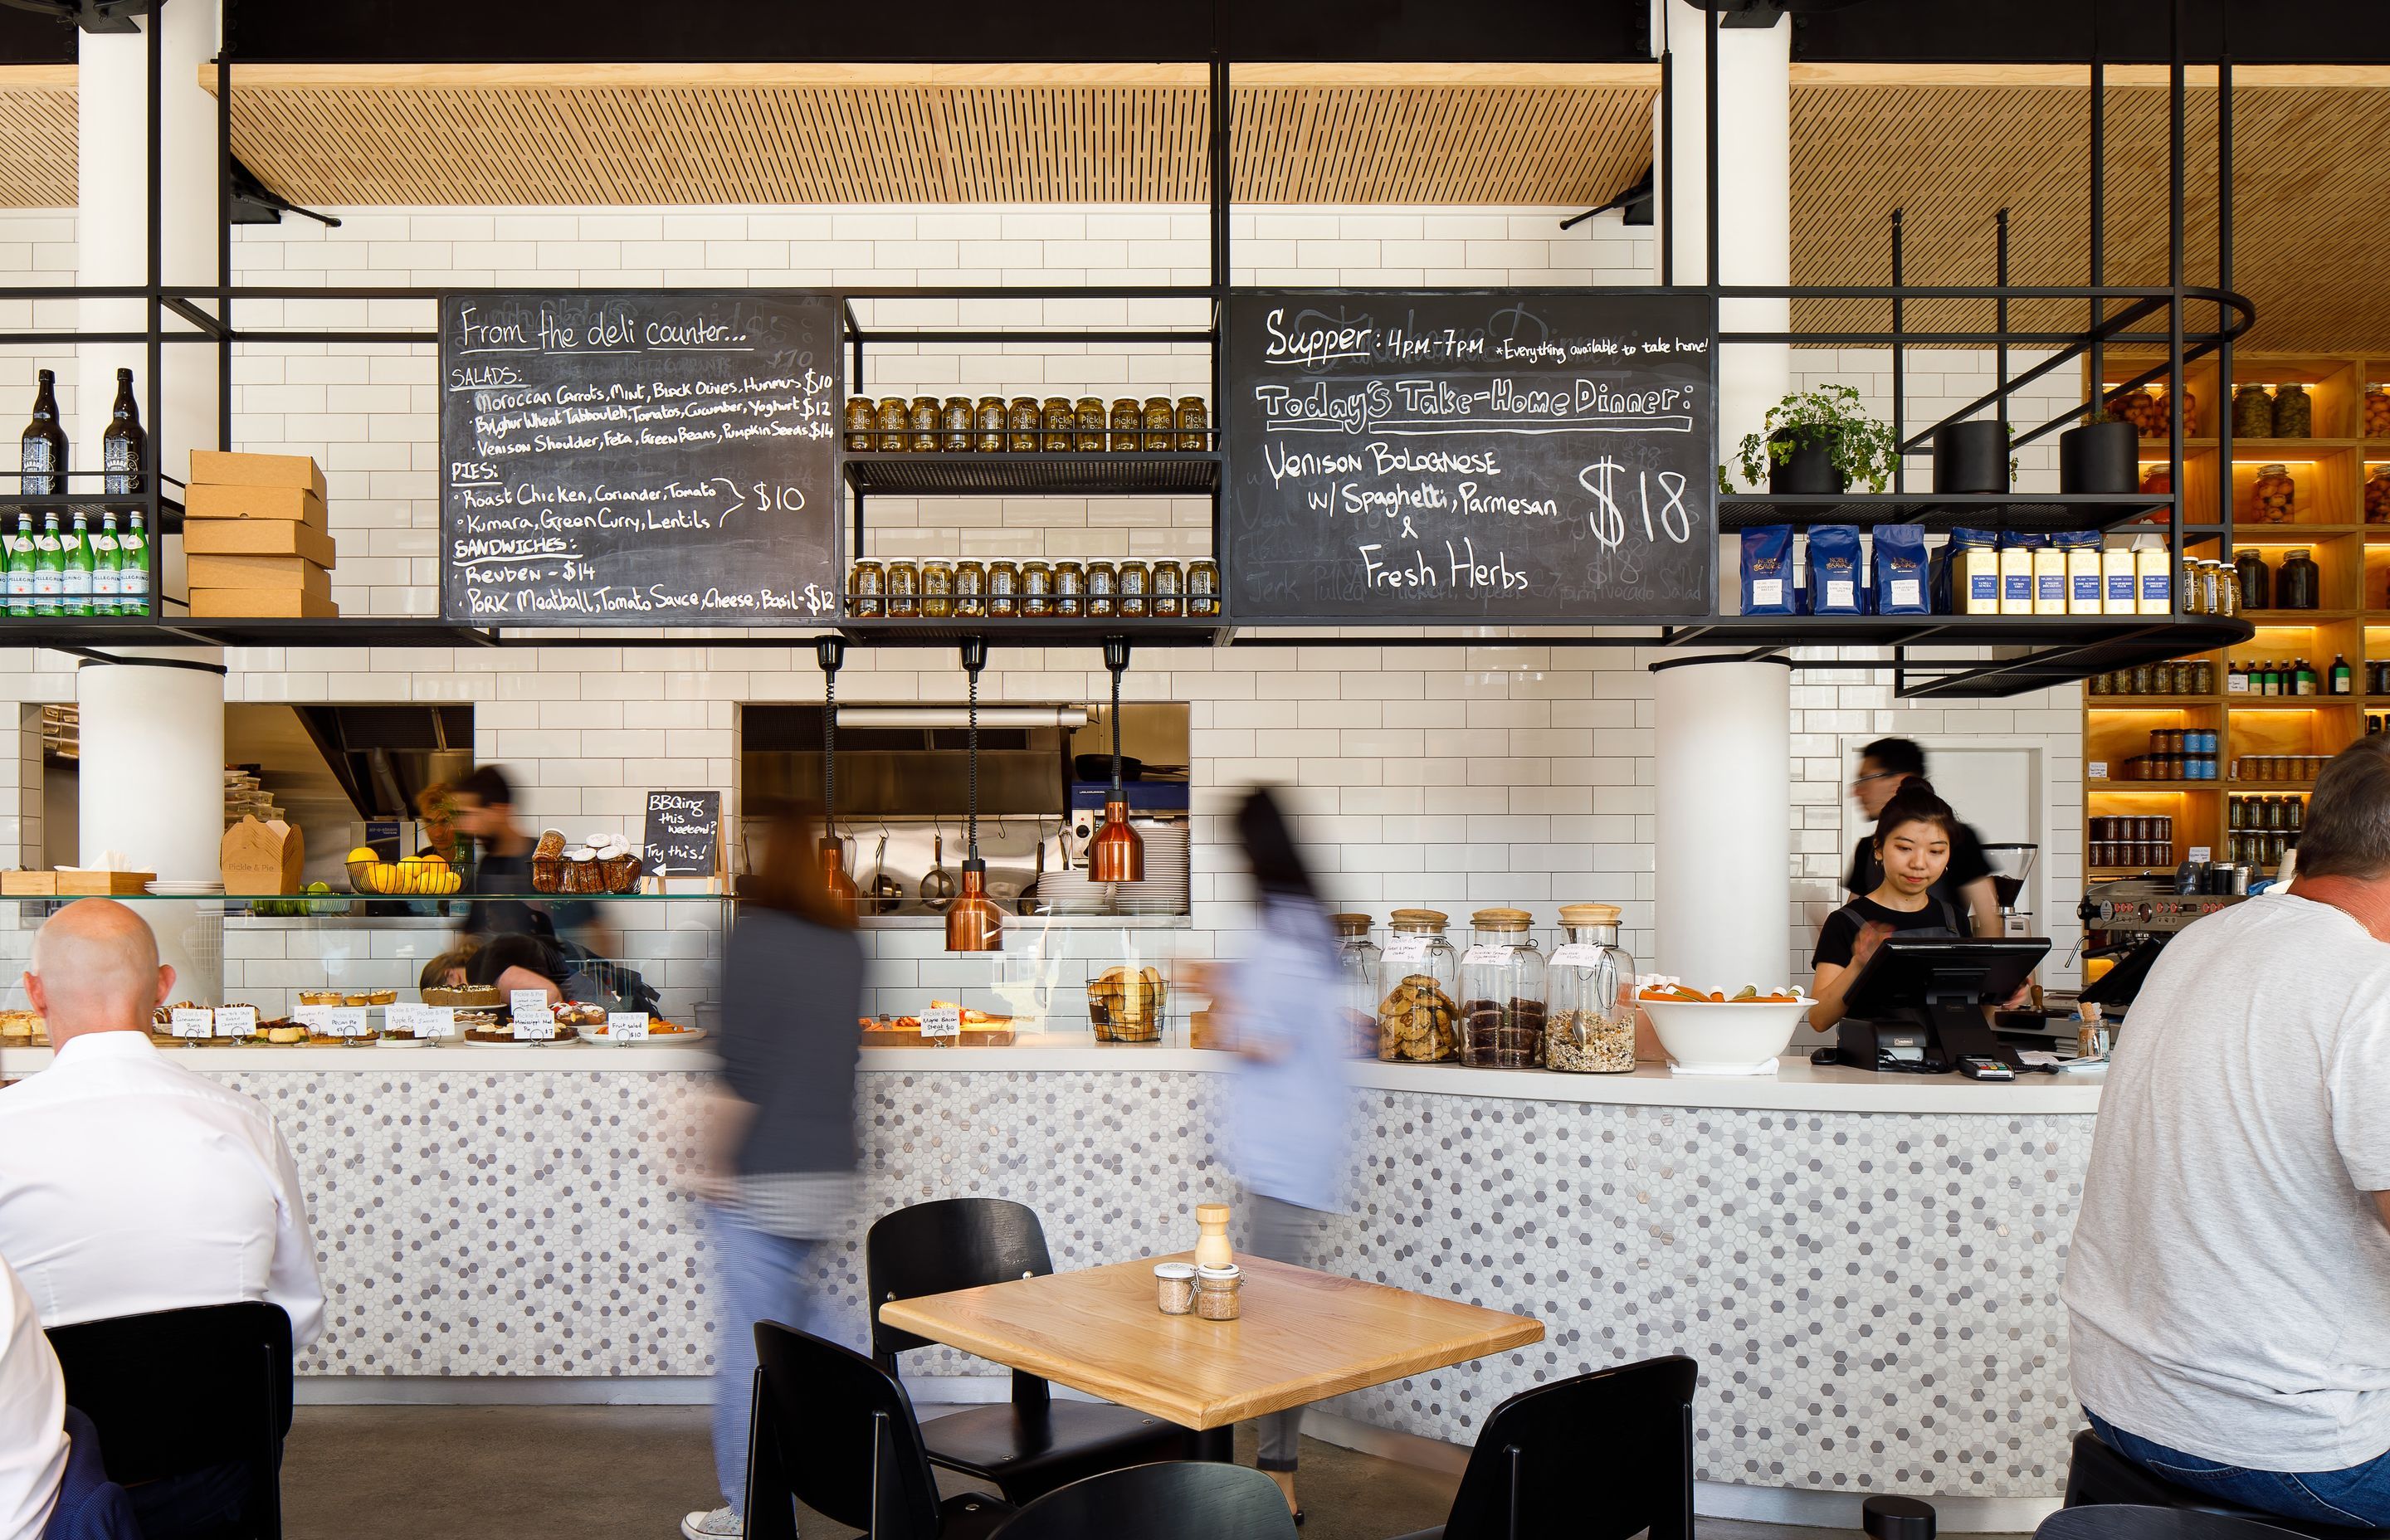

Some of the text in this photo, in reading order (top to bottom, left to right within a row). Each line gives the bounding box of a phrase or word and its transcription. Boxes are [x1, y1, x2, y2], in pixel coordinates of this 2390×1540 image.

[461, 308, 526, 348] From
[538, 310, 578, 349] the
[586, 311, 635, 345] deli
[647, 314, 747, 346] counter...
[1570, 339, 1618, 356] available
[1622, 344, 1636, 356] to
[1641, 336, 1671, 353] take
[1675, 336, 1709, 353] home!
[451, 366, 523, 387] SALADS:
[476, 392, 552, 413] Moroccan
[652, 382, 692, 398] Black
[744, 376, 802, 393] Hummus
[802, 368, 833, 397] $10
[1256, 378, 1695, 435] Today's Take-Home Dinner:
[475, 415, 522, 439] Bulghur
[523, 410, 563, 429] Wheat
[748, 396, 800, 418] Yoghurt
[799, 397, 832, 421] $12
[880, 417, 905, 425] Pickle
[946, 417, 970, 425] Pickle
[980, 416, 1004, 425] Pickle
[1012, 416, 1036, 425] Pickle
[1050, 415, 1073, 425] Pickle
[1081, 415, 1105, 425] Pickle
[1114, 417, 1138, 425] Pickle
[1146, 416, 1170, 425] Pickle
[1185, 415, 1207, 425] Pickle
[477, 440, 532, 457] Venison
[640, 427, 678, 446] Green
[722, 422, 771, 441] Pumpkin
[770, 420, 808, 437] Seeds
[808, 421, 834, 441] $14
[451, 461, 499, 481] PIES:
[463, 486, 513, 509] Roast
[664, 481, 717, 498] Tomato
[752, 480, 806, 512] $10
[1308, 481, 1336, 518] w/
[1458, 481, 1558, 516] Parmesan
[1578, 454, 1691, 555] $18
[539, 508, 597, 532] Green
[646, 509, 711, 530] Lentils
[1401, 515, 1419, 539] &
[453, 537, 578, 558] SANDWICHES:
[562, 560, 596, 582] $14
[1358, 543, 1437, 588] Fresh
[1446, 536, 1529, 590] Herbs
[593, 585, 652, 612] Tomato
[649, 794, 705, 817] BBQing
[658, 812, 685, 824] this
[645, 843, 707, 863] Try this!
[228, 863, 251, 871] Pickle
[261, 864, 274, 872] Pie
